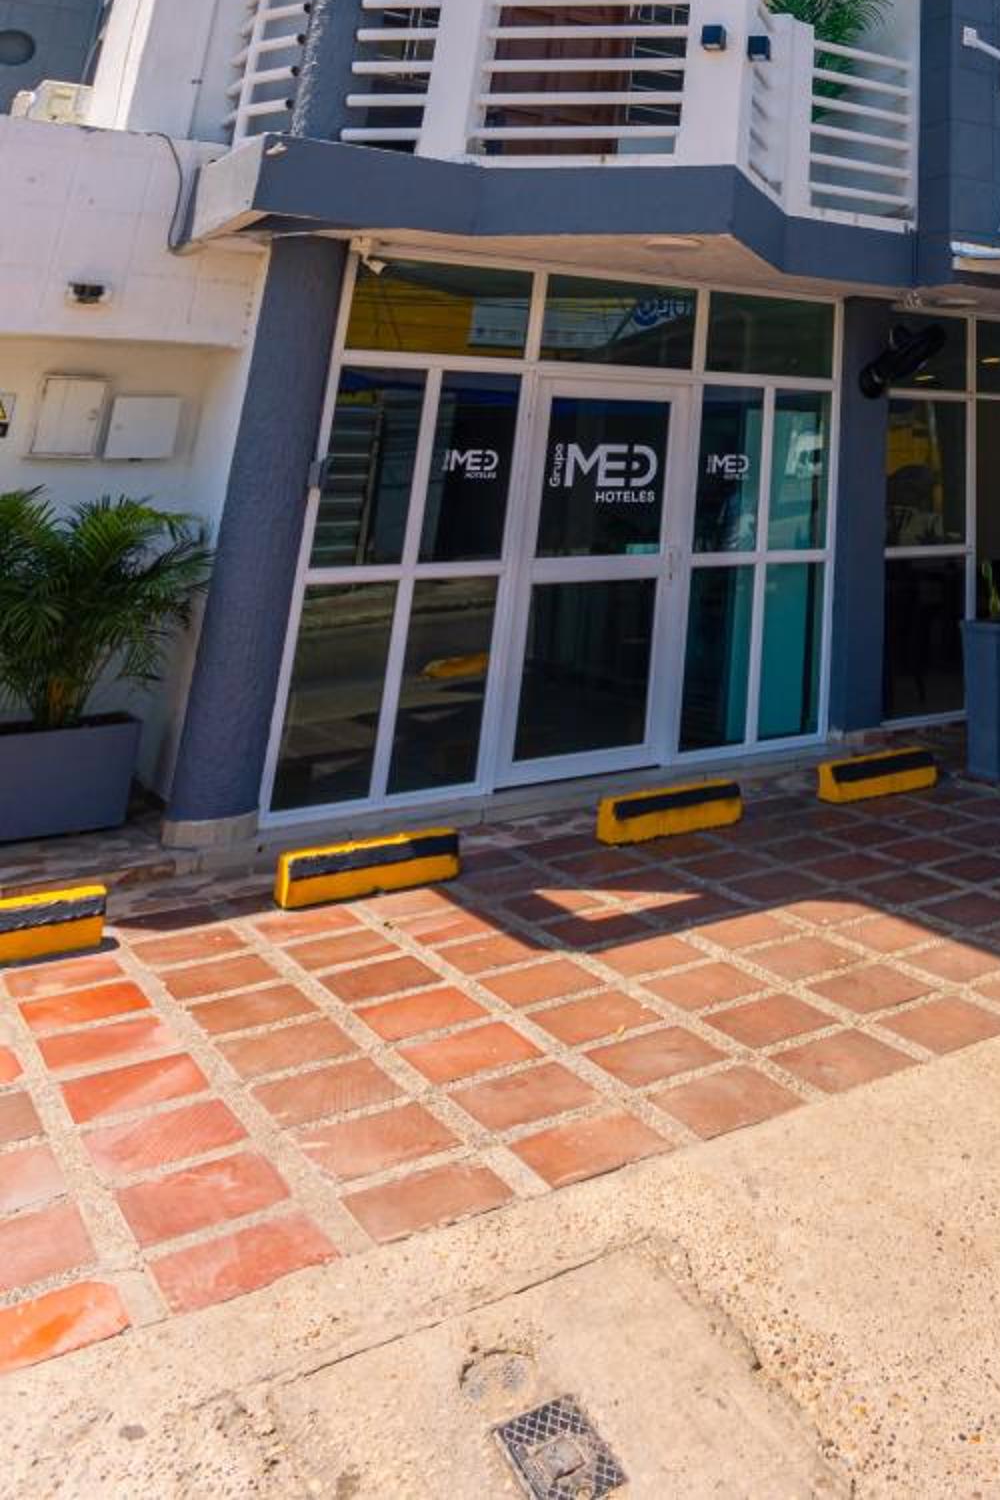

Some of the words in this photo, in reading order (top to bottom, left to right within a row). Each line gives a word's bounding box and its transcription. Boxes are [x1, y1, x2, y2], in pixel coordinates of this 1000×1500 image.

[449, 449, 498, 471] MED
[549, 443, 564, 487] Grupo
[564, 443, 658, 487] MED
[711, 453, 750, 473] MED
[594, 490, 656, 503] HOTELES
